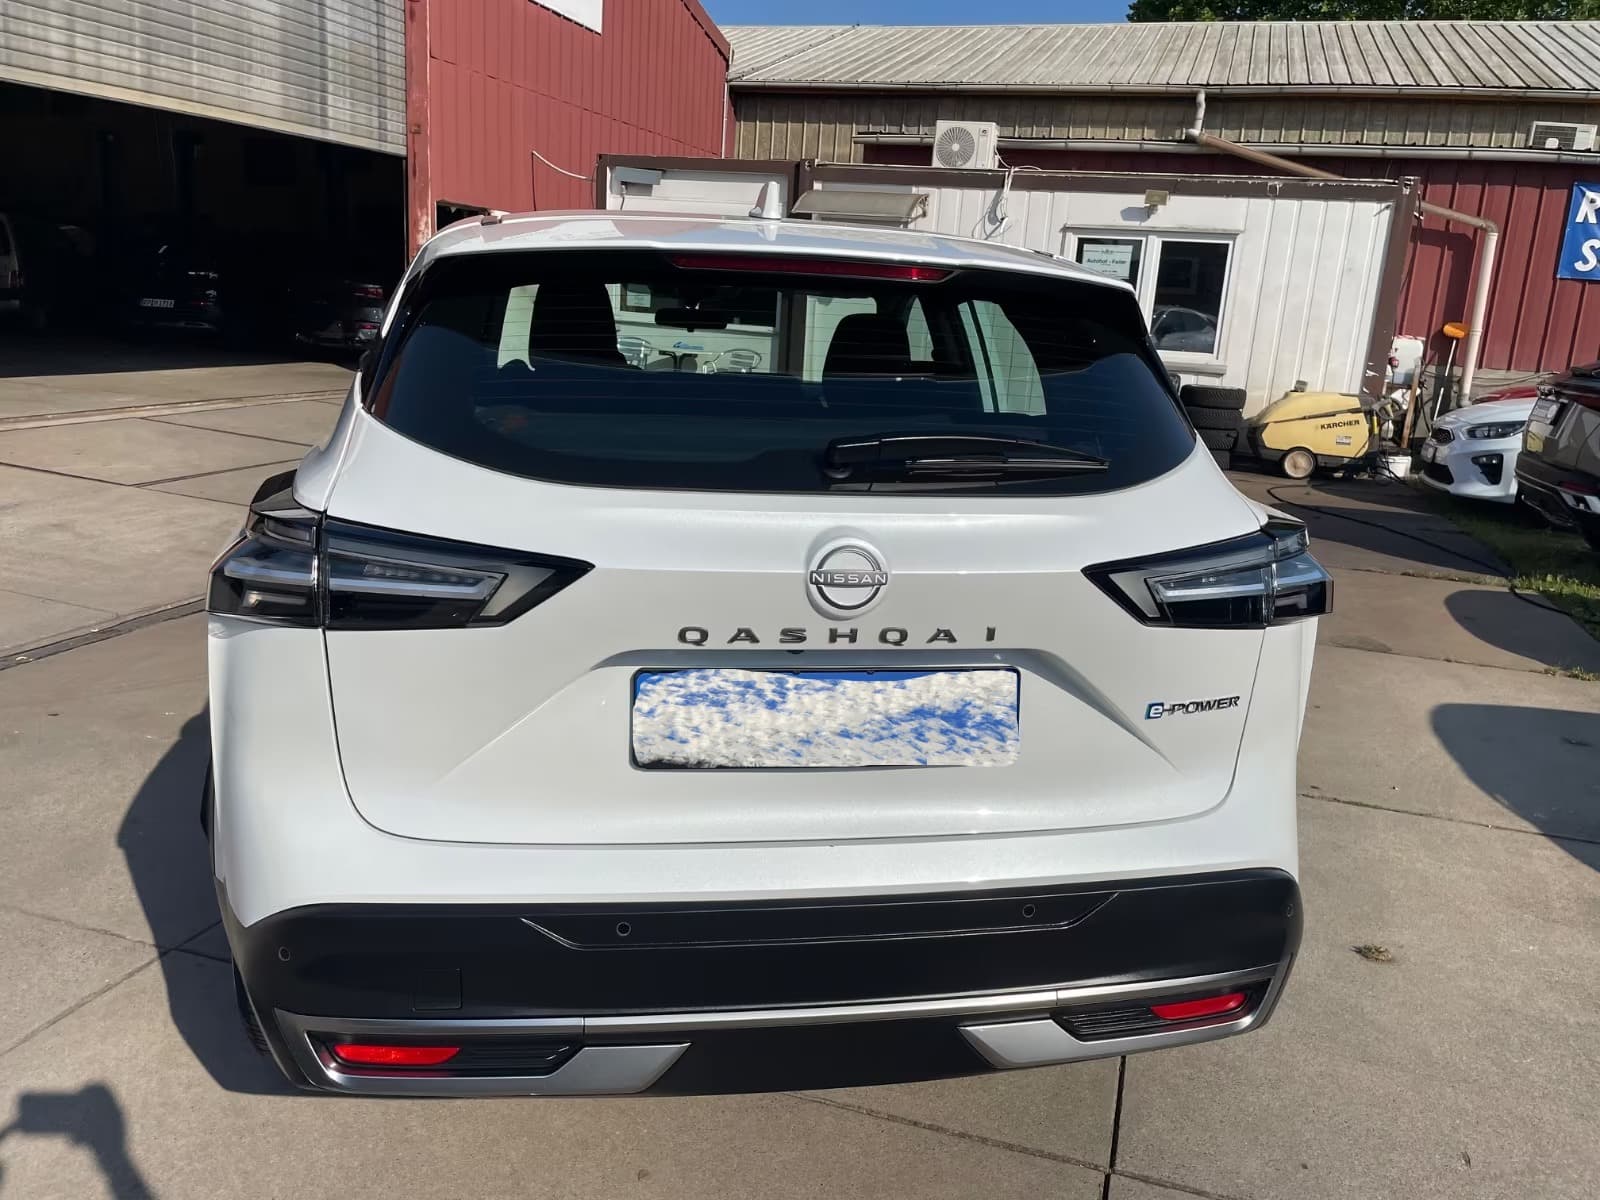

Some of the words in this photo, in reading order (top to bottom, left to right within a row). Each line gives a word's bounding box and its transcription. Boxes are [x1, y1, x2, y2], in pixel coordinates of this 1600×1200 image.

[812, 573, 886, 584] NISSAN
[678, 626, 996, 646] QASHQAI
[1145, 696, 1240, 720] e-POWER
